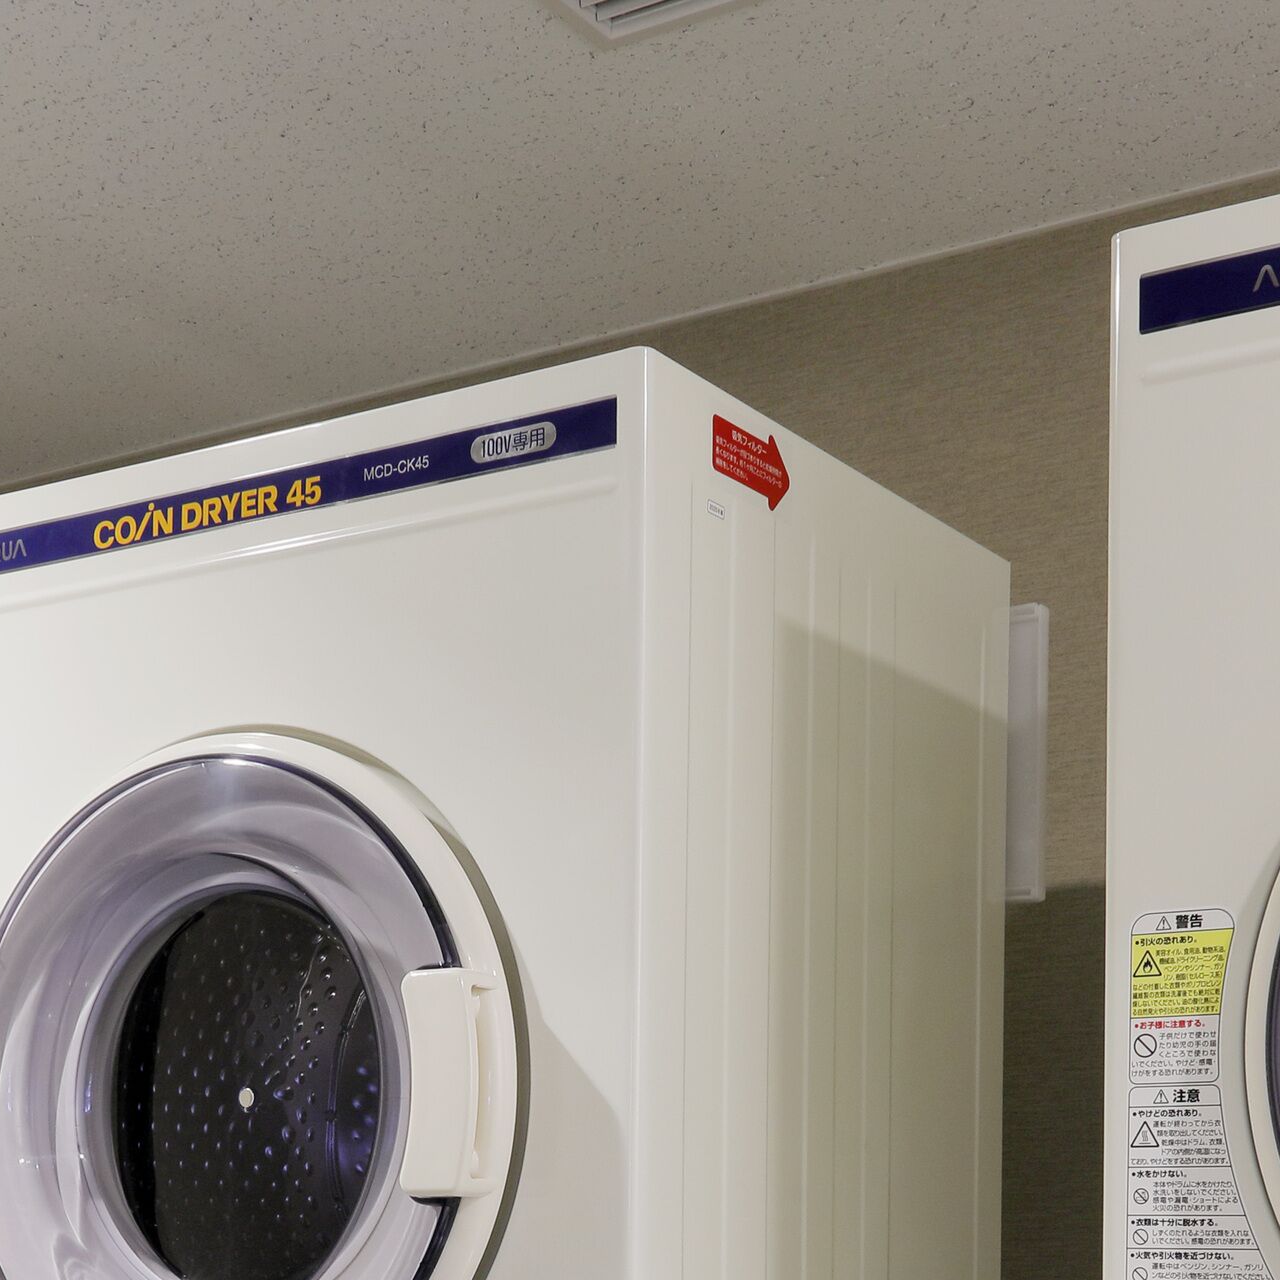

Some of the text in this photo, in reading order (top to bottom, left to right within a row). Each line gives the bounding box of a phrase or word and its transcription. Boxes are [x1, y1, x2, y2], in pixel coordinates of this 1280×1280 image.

[480, 427, 546, 459] 100V専用
[363, 455, 430, 482] MCD-CK45
[181, 490, 278, 533] DRYER
[286, 476, 321, 508] 45
[1176, 914, 1203, 929] 警告
[1140, 936, 1197, 946] 引火の恐れあり。
[1140, 1020, 1205, 1029] お子様に注意する。
[1159, 1031, 1216, 1040] 子供だけで使わせ
[1159, 1050, 1216, 1058] くところで使わな
[1173, 1089, 1200, 1103] 注意
[1138, 1109, 1202, 1117] やけどの恐れあり。
[1136, 1170, 1187, 1178] 水をかけない。
[1152, 1204, 1223, 1212] 火災の恐れがあります。
[1136, 1218, 1218, 1227] 衣類は十分に脱水する。
[1135, 1251, 1235, 1261] 火気や引火物を近づけない。
